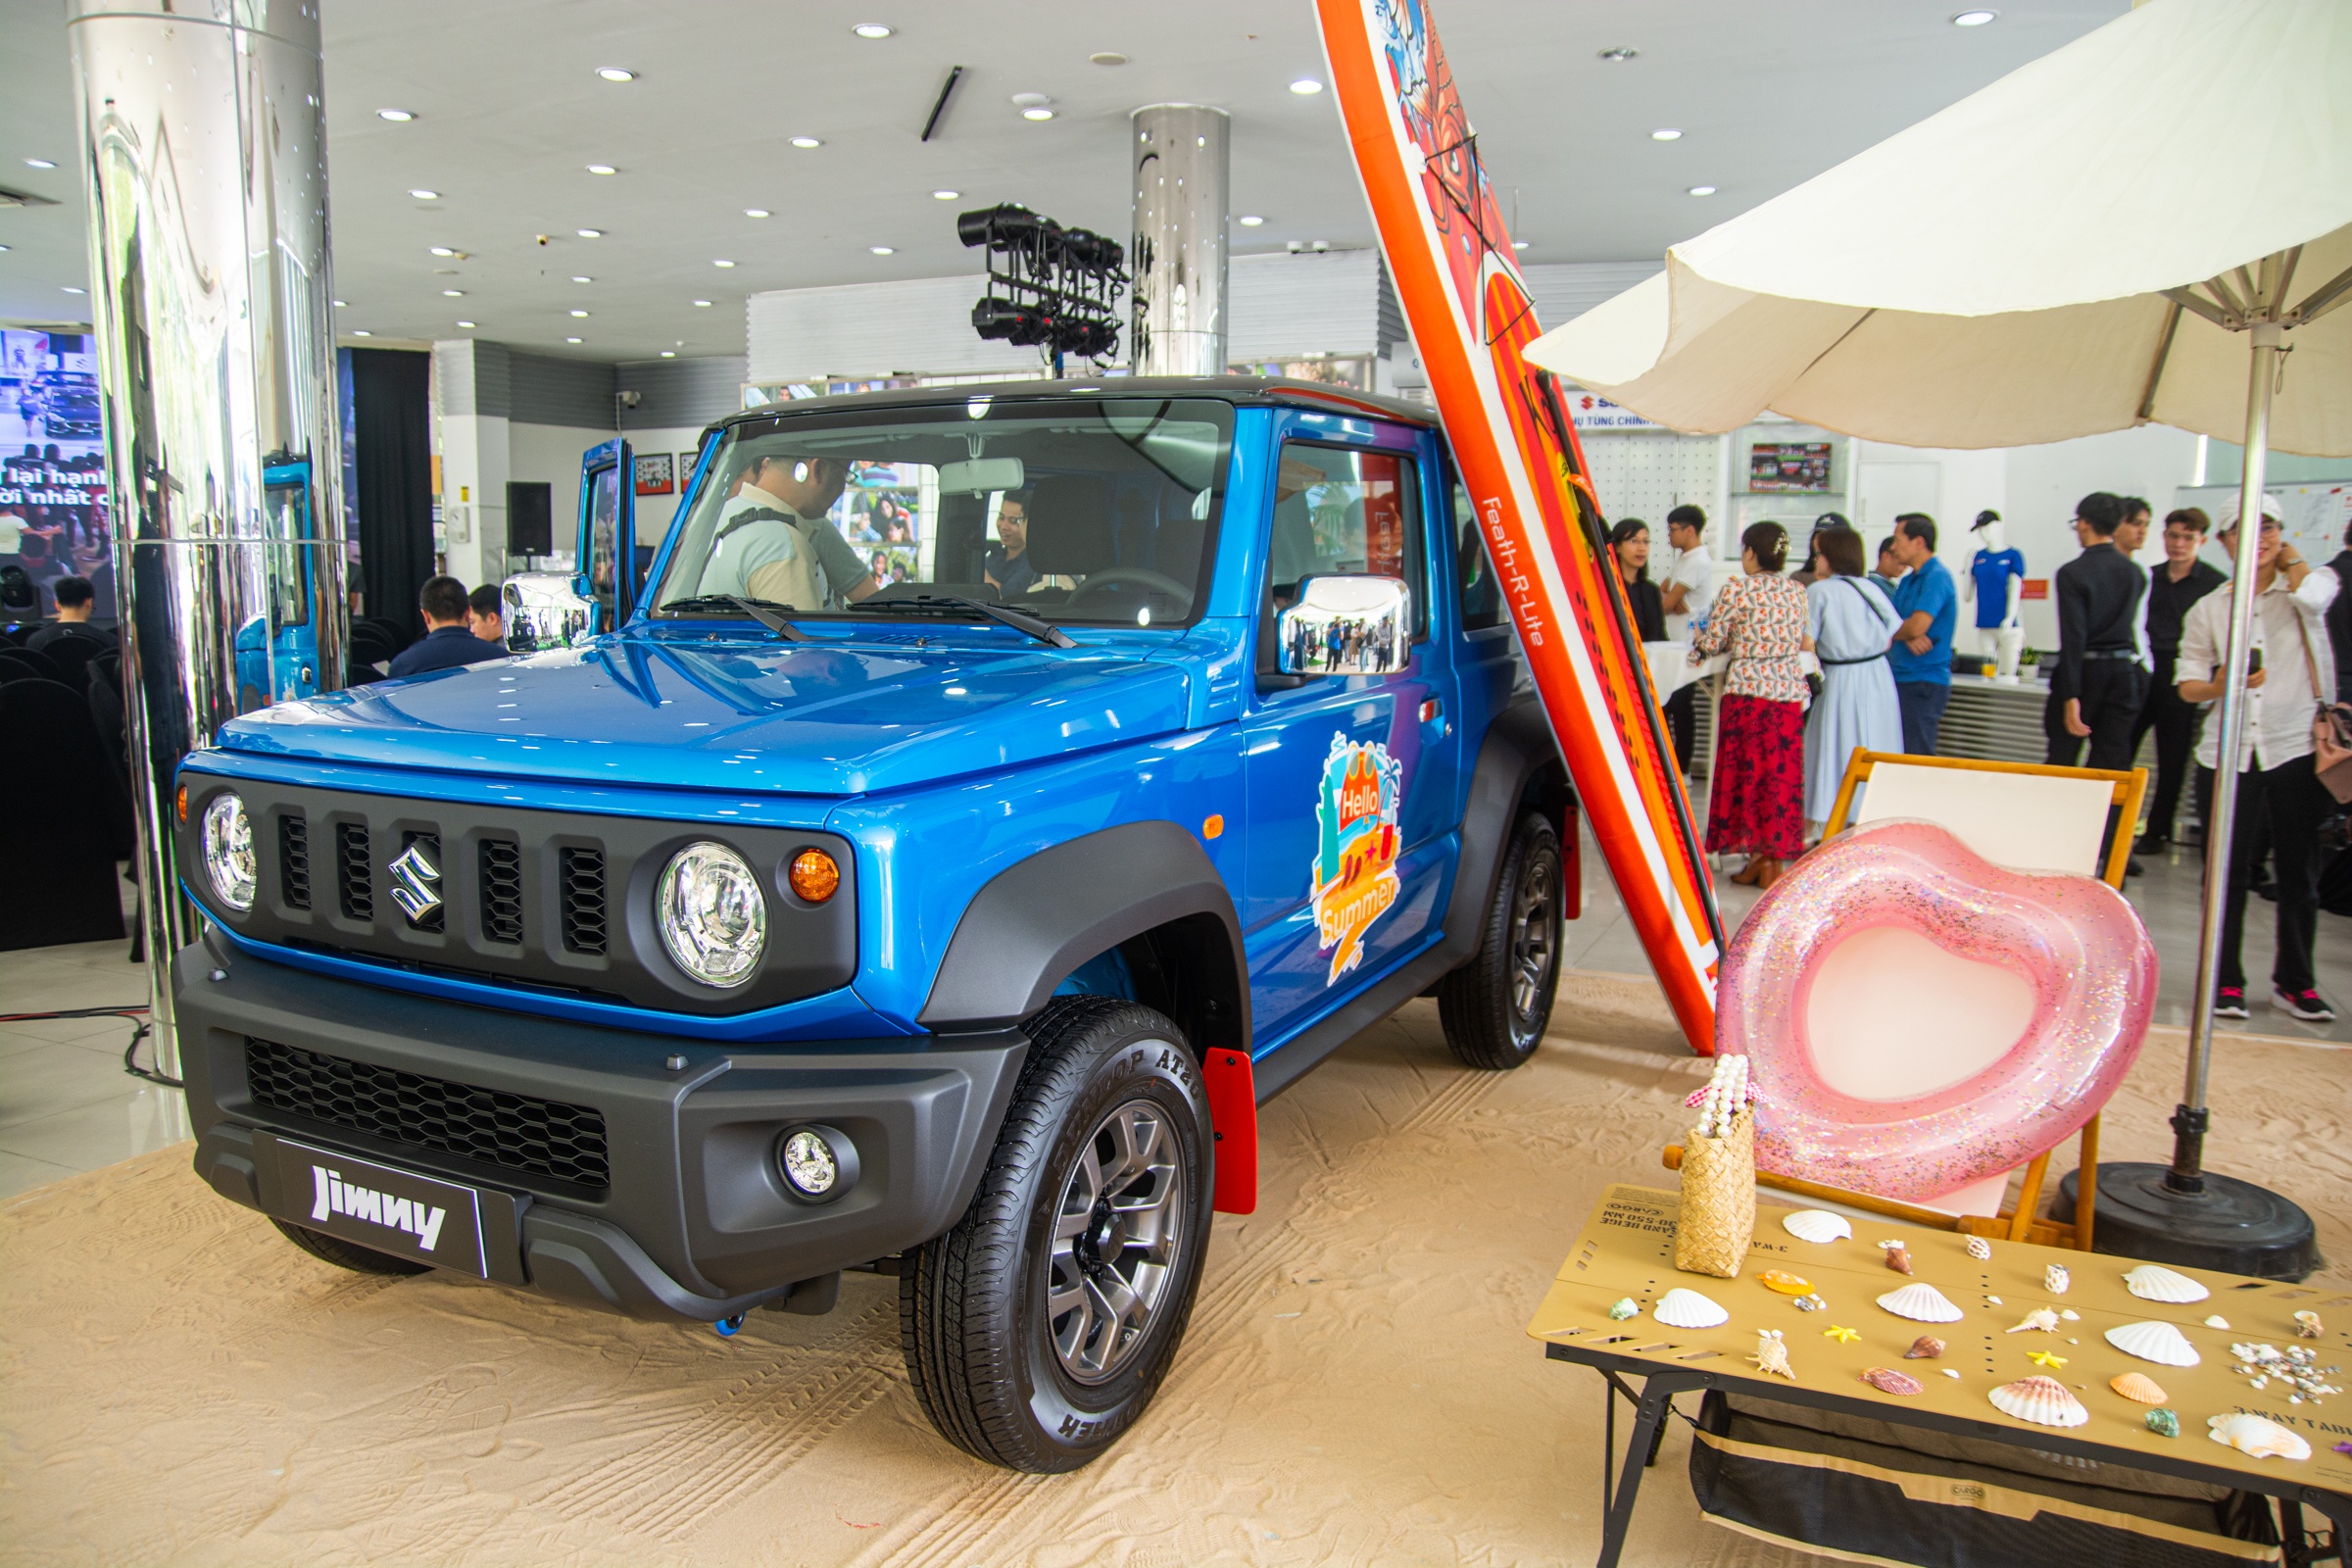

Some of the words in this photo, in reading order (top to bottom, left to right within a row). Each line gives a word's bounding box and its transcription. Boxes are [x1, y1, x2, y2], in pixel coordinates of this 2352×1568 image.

[0, 487, 24, 505] ời
[30, 488, 92, 505] nhất
[1482, 497, 1544, 647] Feath-R-Lite
[1342, 785, 1379, 819] Hello
[1322, 879, 1395, 945] Summer
[1154, 1049, 1202, 1102] AT20
[1602, 1210, 1625, 1220] MM
[1609, 1203, 1661, 1216] CARGO
[1599, 1216, 1642, 1230] BEIGE
[1748, 1241, 1788, 1253] 3-WA
[2303, 1418, 2352, 1437] TABL
